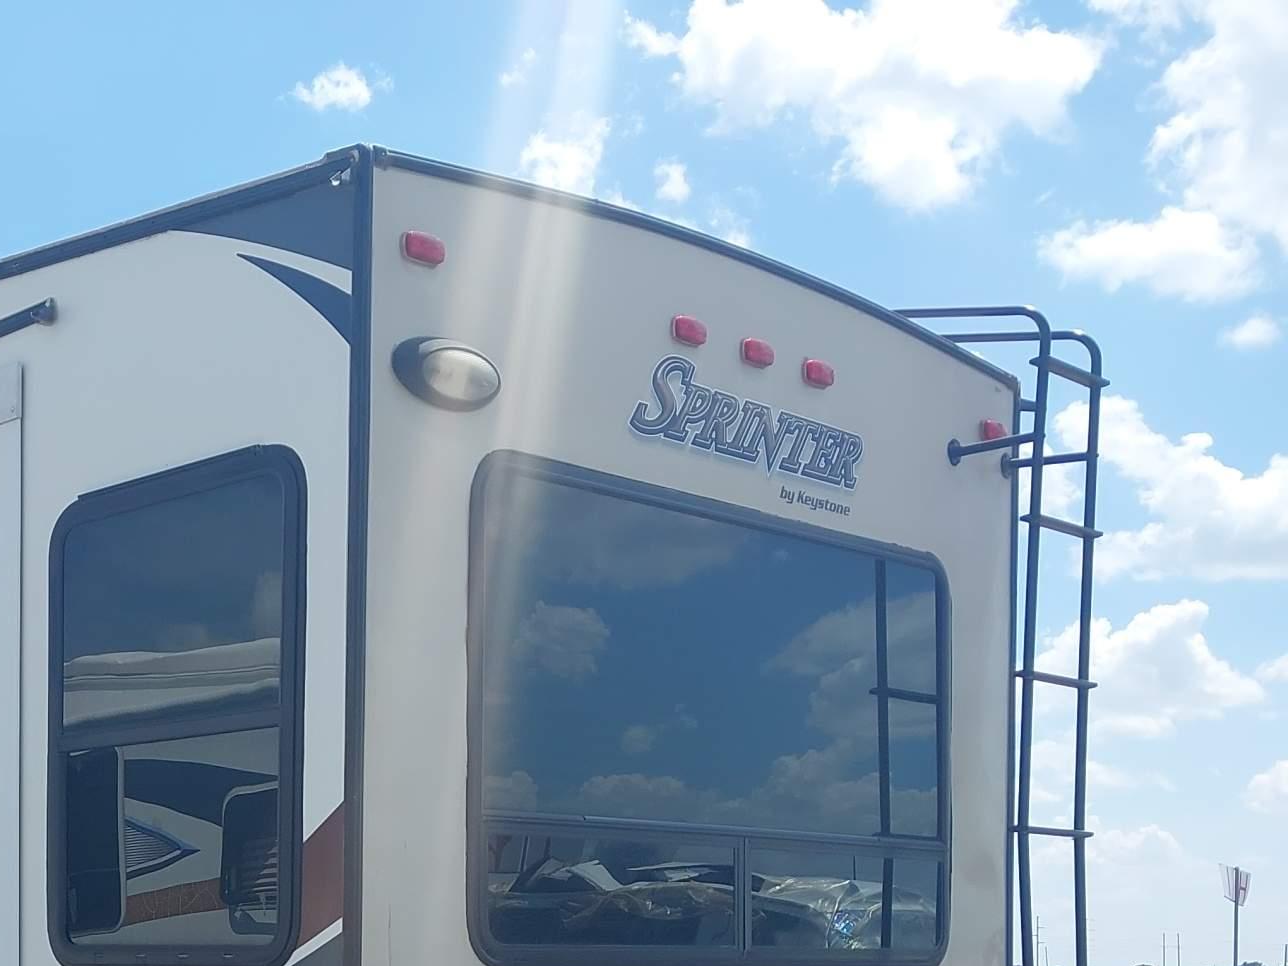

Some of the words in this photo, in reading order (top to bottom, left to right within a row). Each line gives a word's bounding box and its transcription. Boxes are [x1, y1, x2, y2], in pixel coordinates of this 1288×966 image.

[629, 354, 864, 490] SPRINTER
[779, 485, 795, 504] by
[796, 490, 851, 516] Keystone
